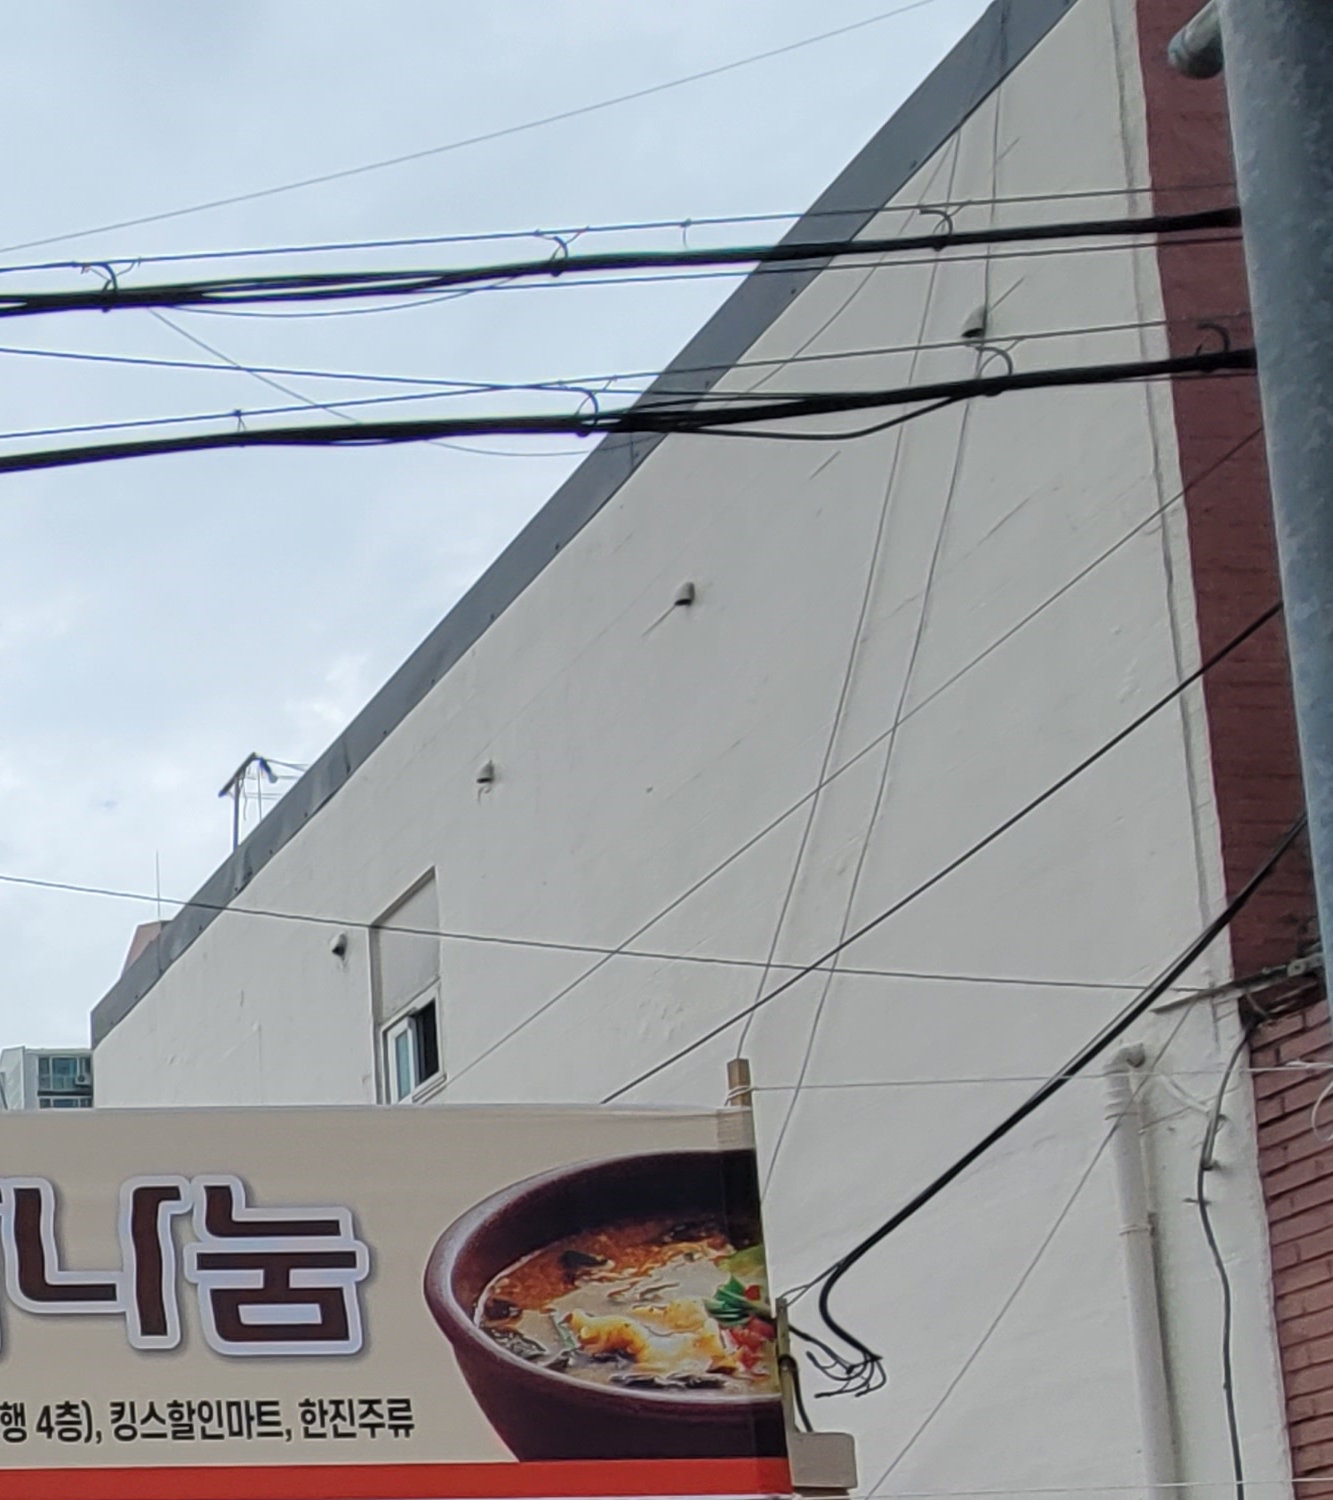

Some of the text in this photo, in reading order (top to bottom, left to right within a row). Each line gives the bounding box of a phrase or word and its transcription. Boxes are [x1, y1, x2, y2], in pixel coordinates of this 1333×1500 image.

[35, 1401, 104, 1446] 4층),
[109, 1400, 295, 1444] 킹스할인마트,
[298, 1397, 415, 1441] 한진주류
